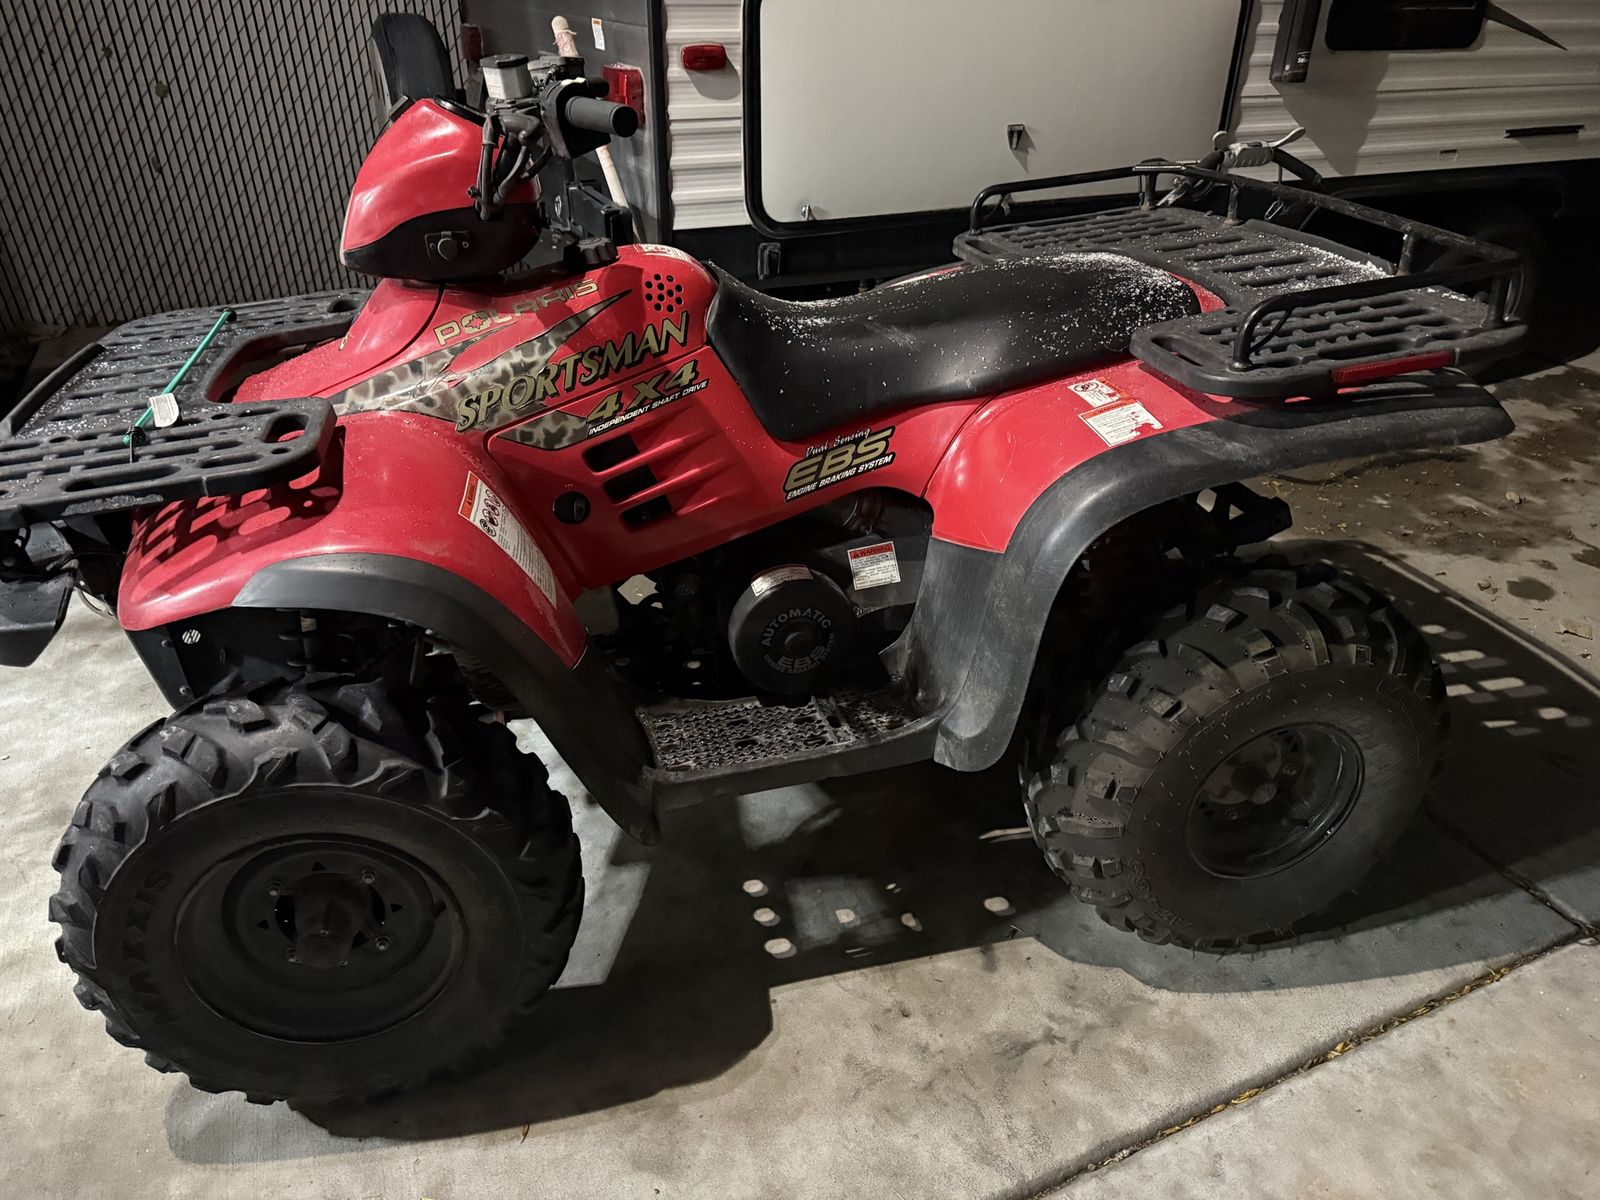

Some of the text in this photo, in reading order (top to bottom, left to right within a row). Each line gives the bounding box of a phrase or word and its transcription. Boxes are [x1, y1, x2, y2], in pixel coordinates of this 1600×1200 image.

[432, 278, 599, 346] POLARIS
[455, 311, 690, 433] SPORTSMAN
[585, 360, 699, 423] 4X4
[588, 380, 708, 436] INDEPENDENT SHAFT DRIVE
[784, 427, 893, 491] EBS
[805, 427, 872, 458] Dual Sensing
[786, 454, 893, 500] ENGINE BRAKING SYSTEM
[859, 544, 892, 556] WARNING
[761, 608, 832, 647] AUTOMATIC
[777, 645, 826, 669] EBS
[121, 871, 181, 1025] MAXXIS
